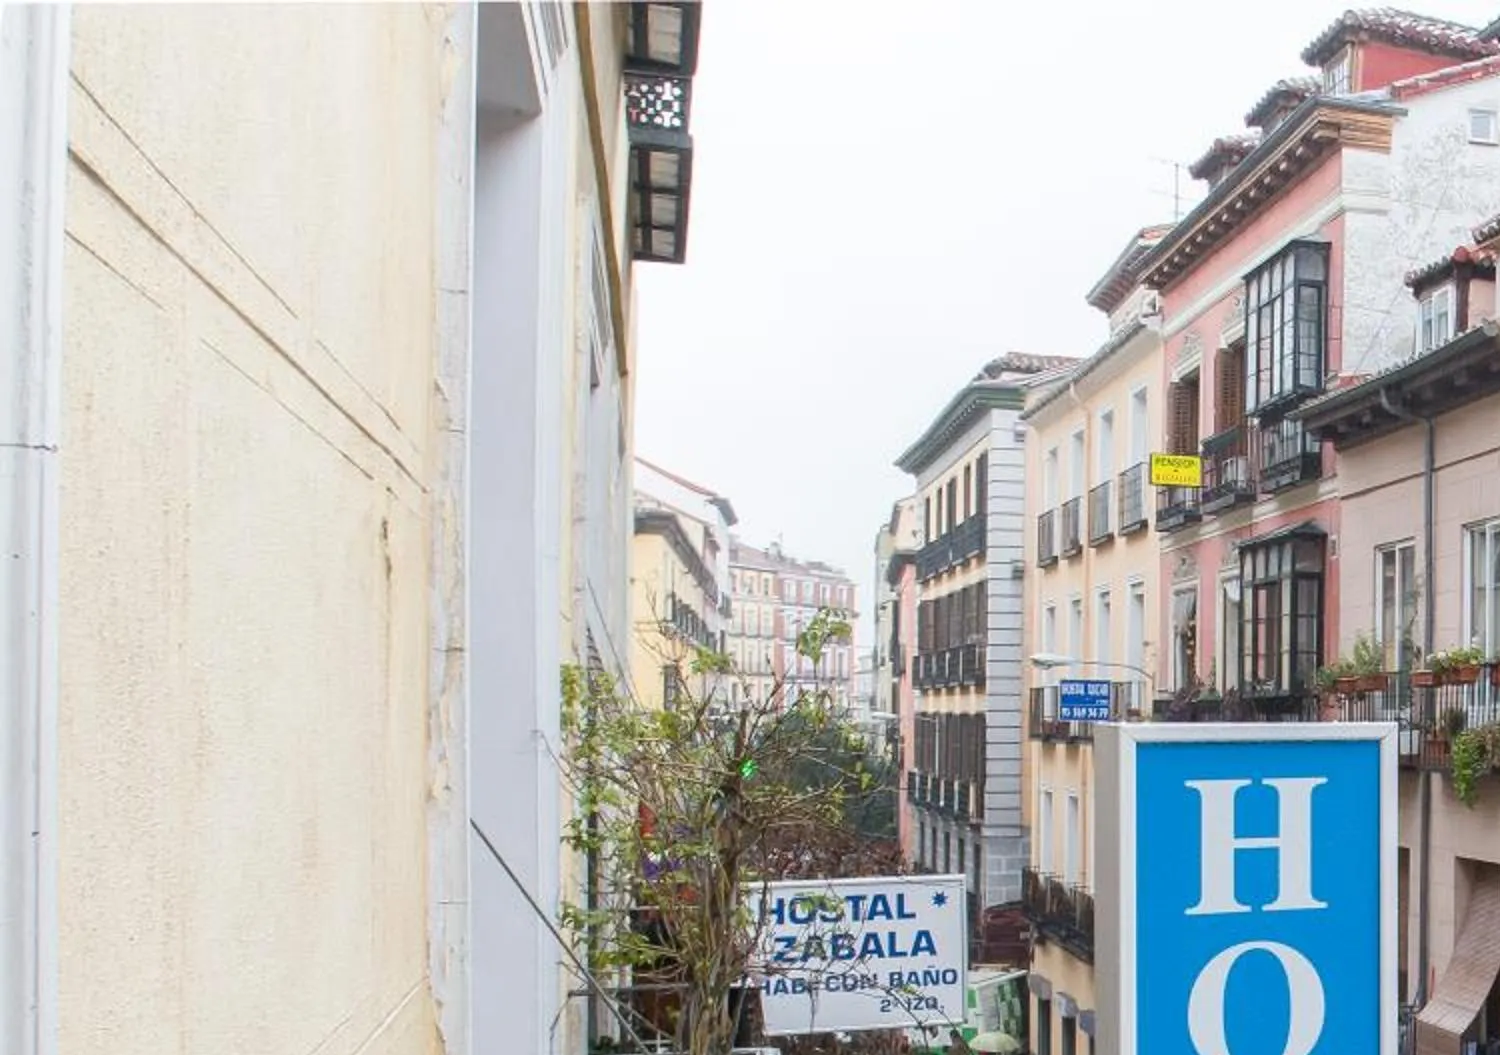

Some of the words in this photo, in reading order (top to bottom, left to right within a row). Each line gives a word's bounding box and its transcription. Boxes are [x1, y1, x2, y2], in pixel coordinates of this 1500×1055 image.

[758, 893, 916, 925] HOSTAL
[772, 930, 937, 963] ZABALA
[889, 965, 958, 988] BAÑO
